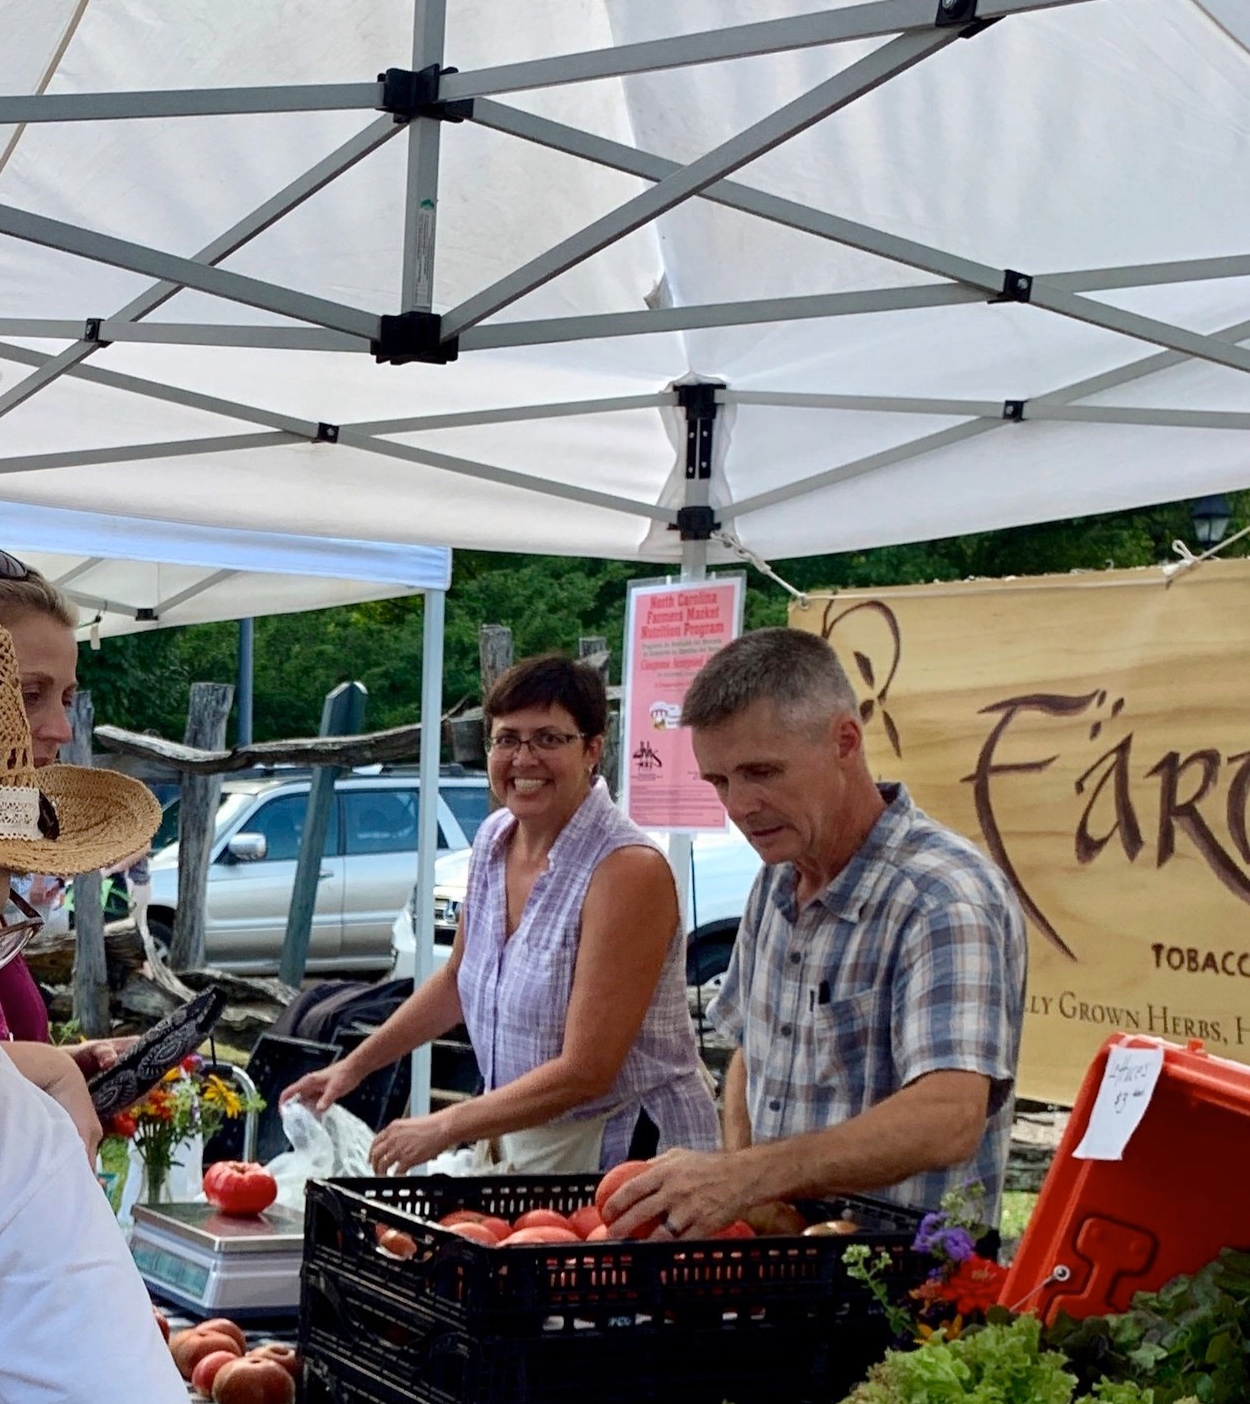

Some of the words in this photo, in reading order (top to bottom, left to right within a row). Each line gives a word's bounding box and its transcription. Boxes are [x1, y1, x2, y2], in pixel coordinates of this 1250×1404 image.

[678, 592, 717, 607] Carolina
[647, 611, 683, 624] Farmers
[686, 606, 719, 621] Market
[641, 626, 681, 639] Nutrition
[684, 623, 724, 638] Program
